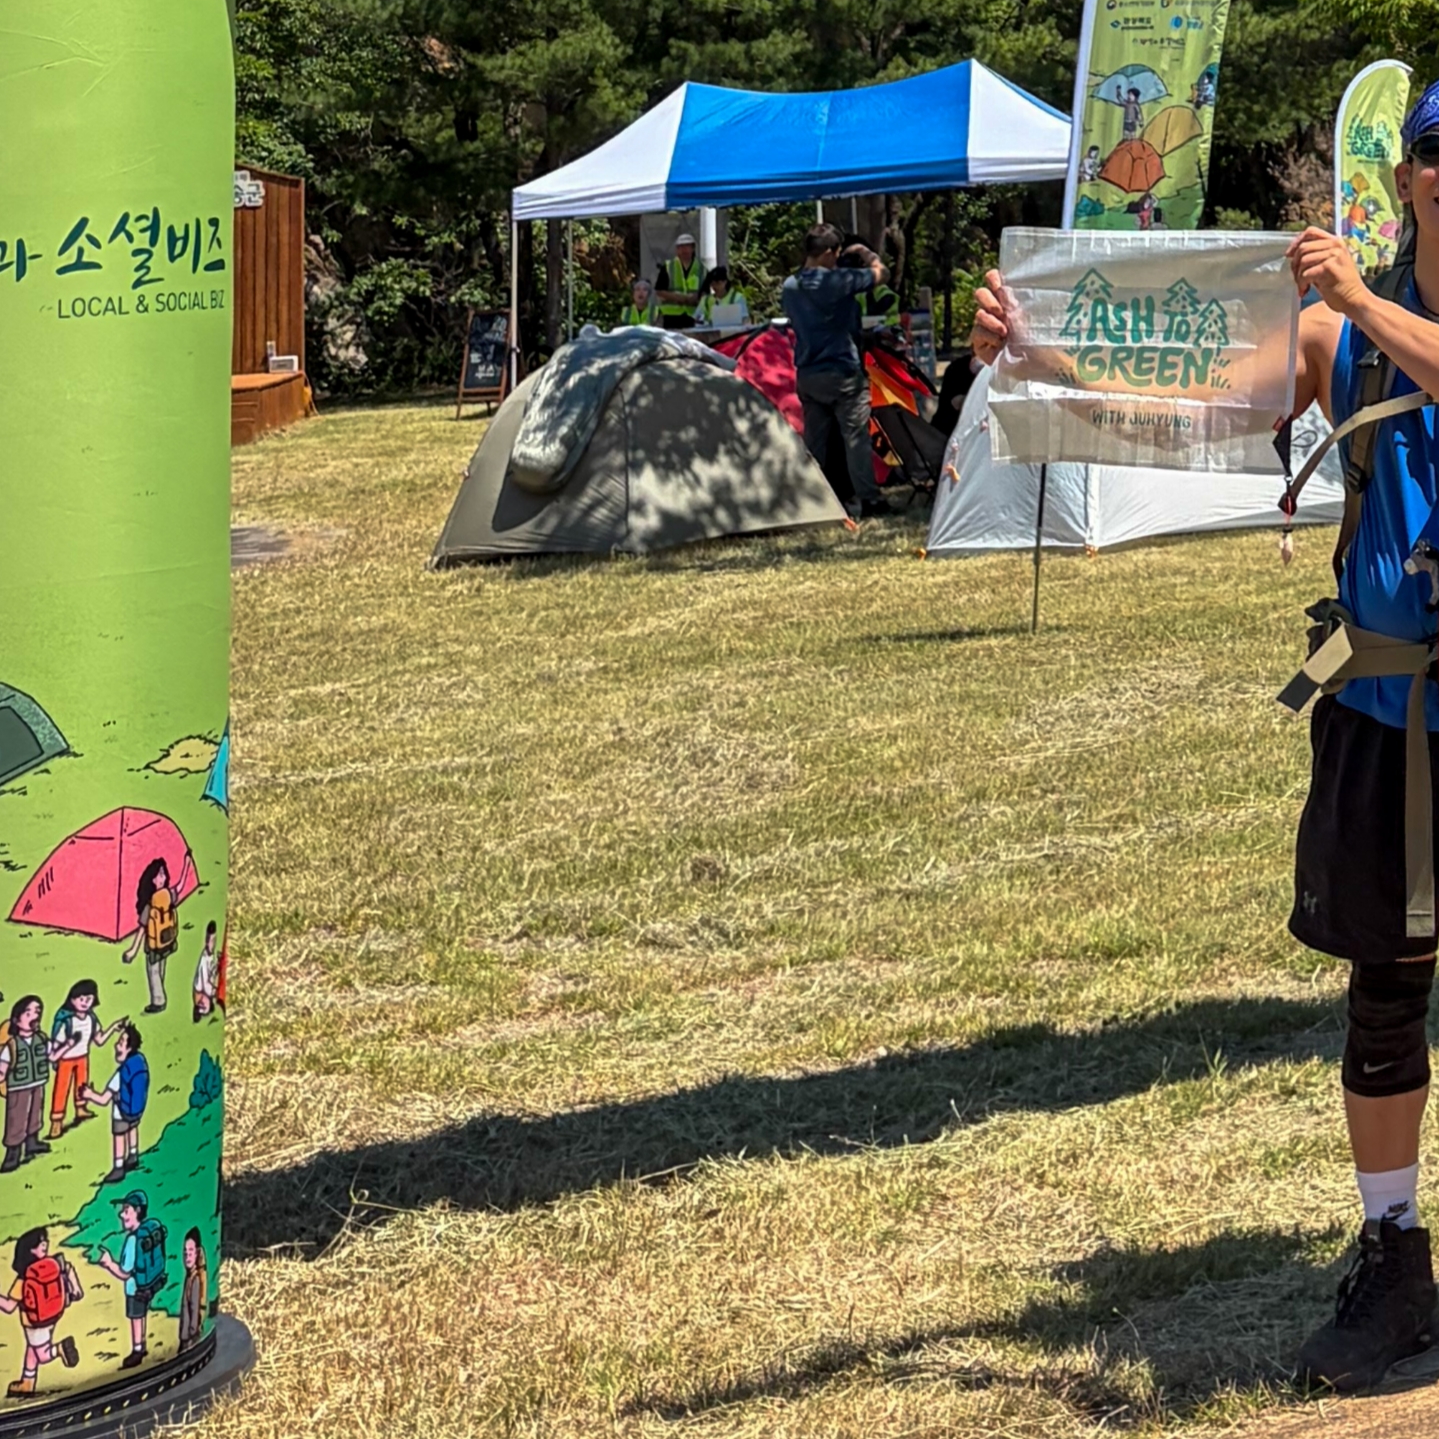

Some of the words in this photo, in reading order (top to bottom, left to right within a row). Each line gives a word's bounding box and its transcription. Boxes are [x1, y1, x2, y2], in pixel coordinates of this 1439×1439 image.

[55, 206, 225, 290] 소셜비즈
[58, 296, 130, 320] LOCAL
[136, 294, 149, 314] &
[155, 290, 208, 313] SOCIAL
[1086, 295, 1155, 343] ASH
[1162, 312, 1192, 342] TO
[1076, 345, 1213, 389] GREEN
[1092, 409, 1125, 425] WITH
